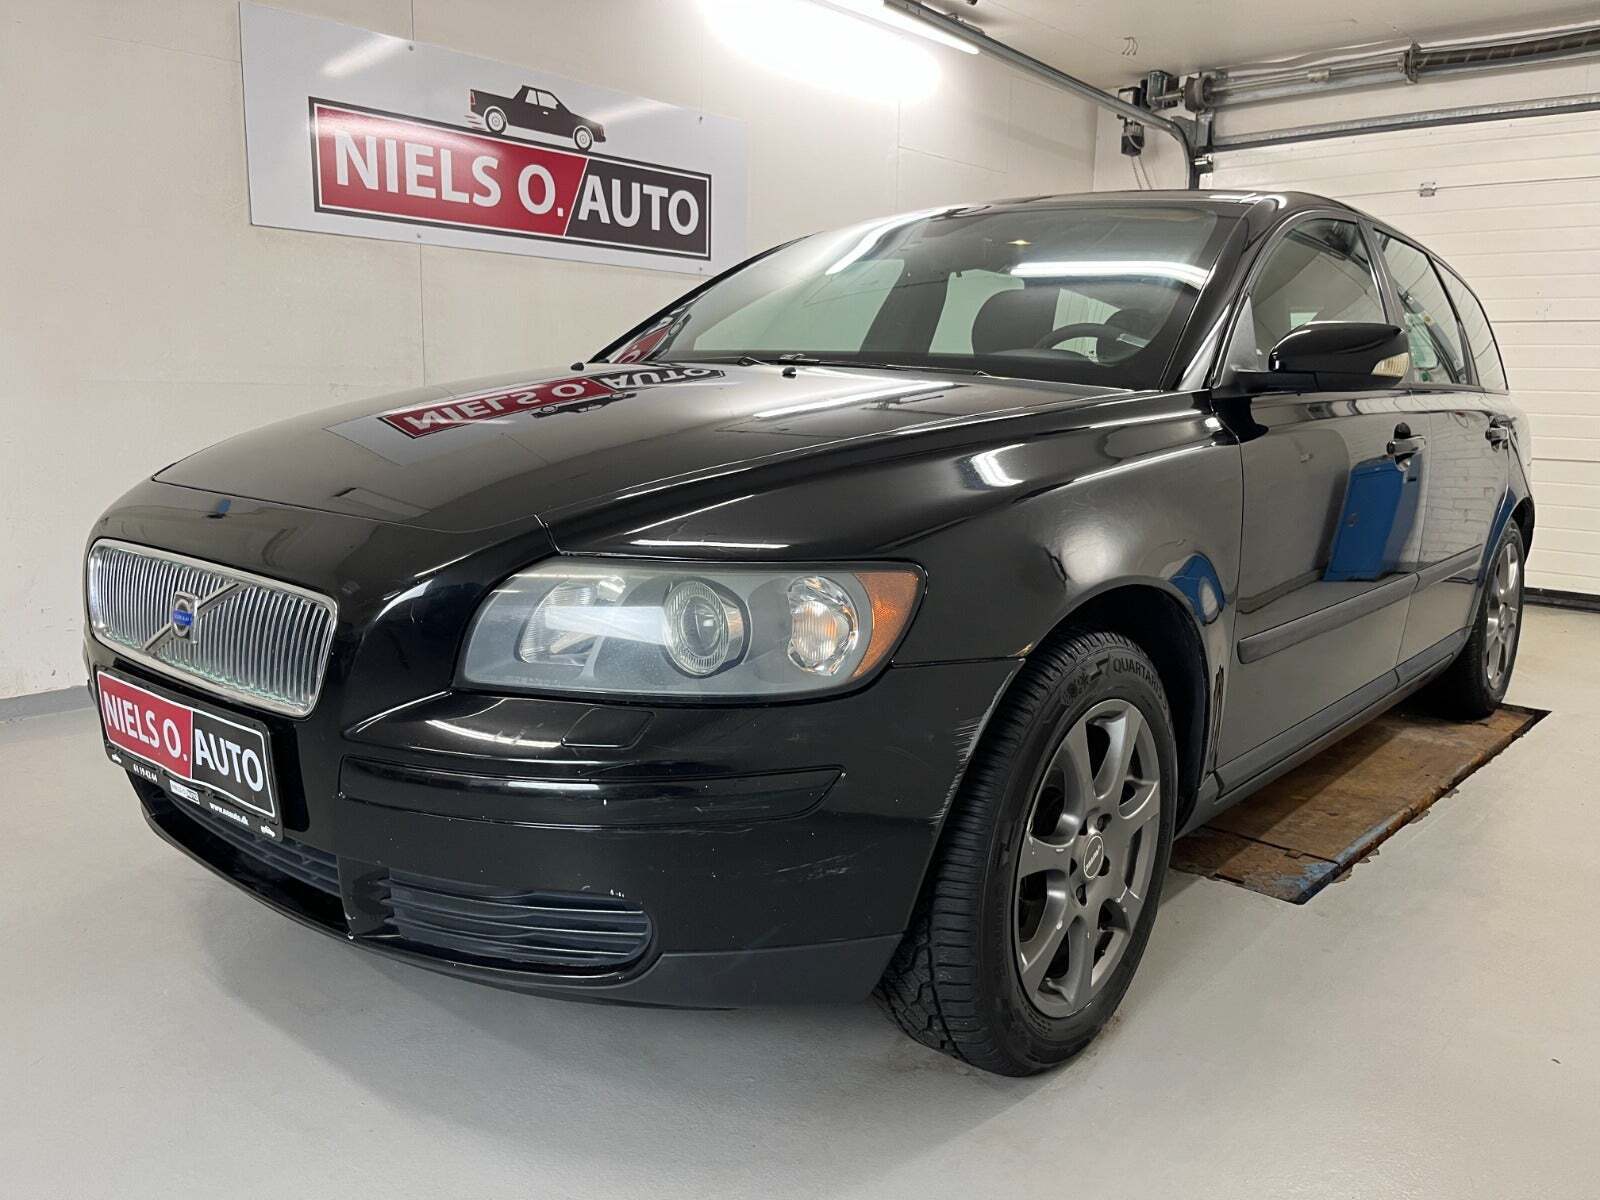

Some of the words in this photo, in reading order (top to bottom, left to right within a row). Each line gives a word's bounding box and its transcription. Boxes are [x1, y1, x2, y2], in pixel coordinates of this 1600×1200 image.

[333, 134, 501, 208] NIELS
[517, 164, 564, 217] O.
[578, 174, 699, 236] AUTO
[103, 690, 160, 748] NIELS
[163, 718, 187, 761] O.
[194, 728, 263, 792] AUTO
